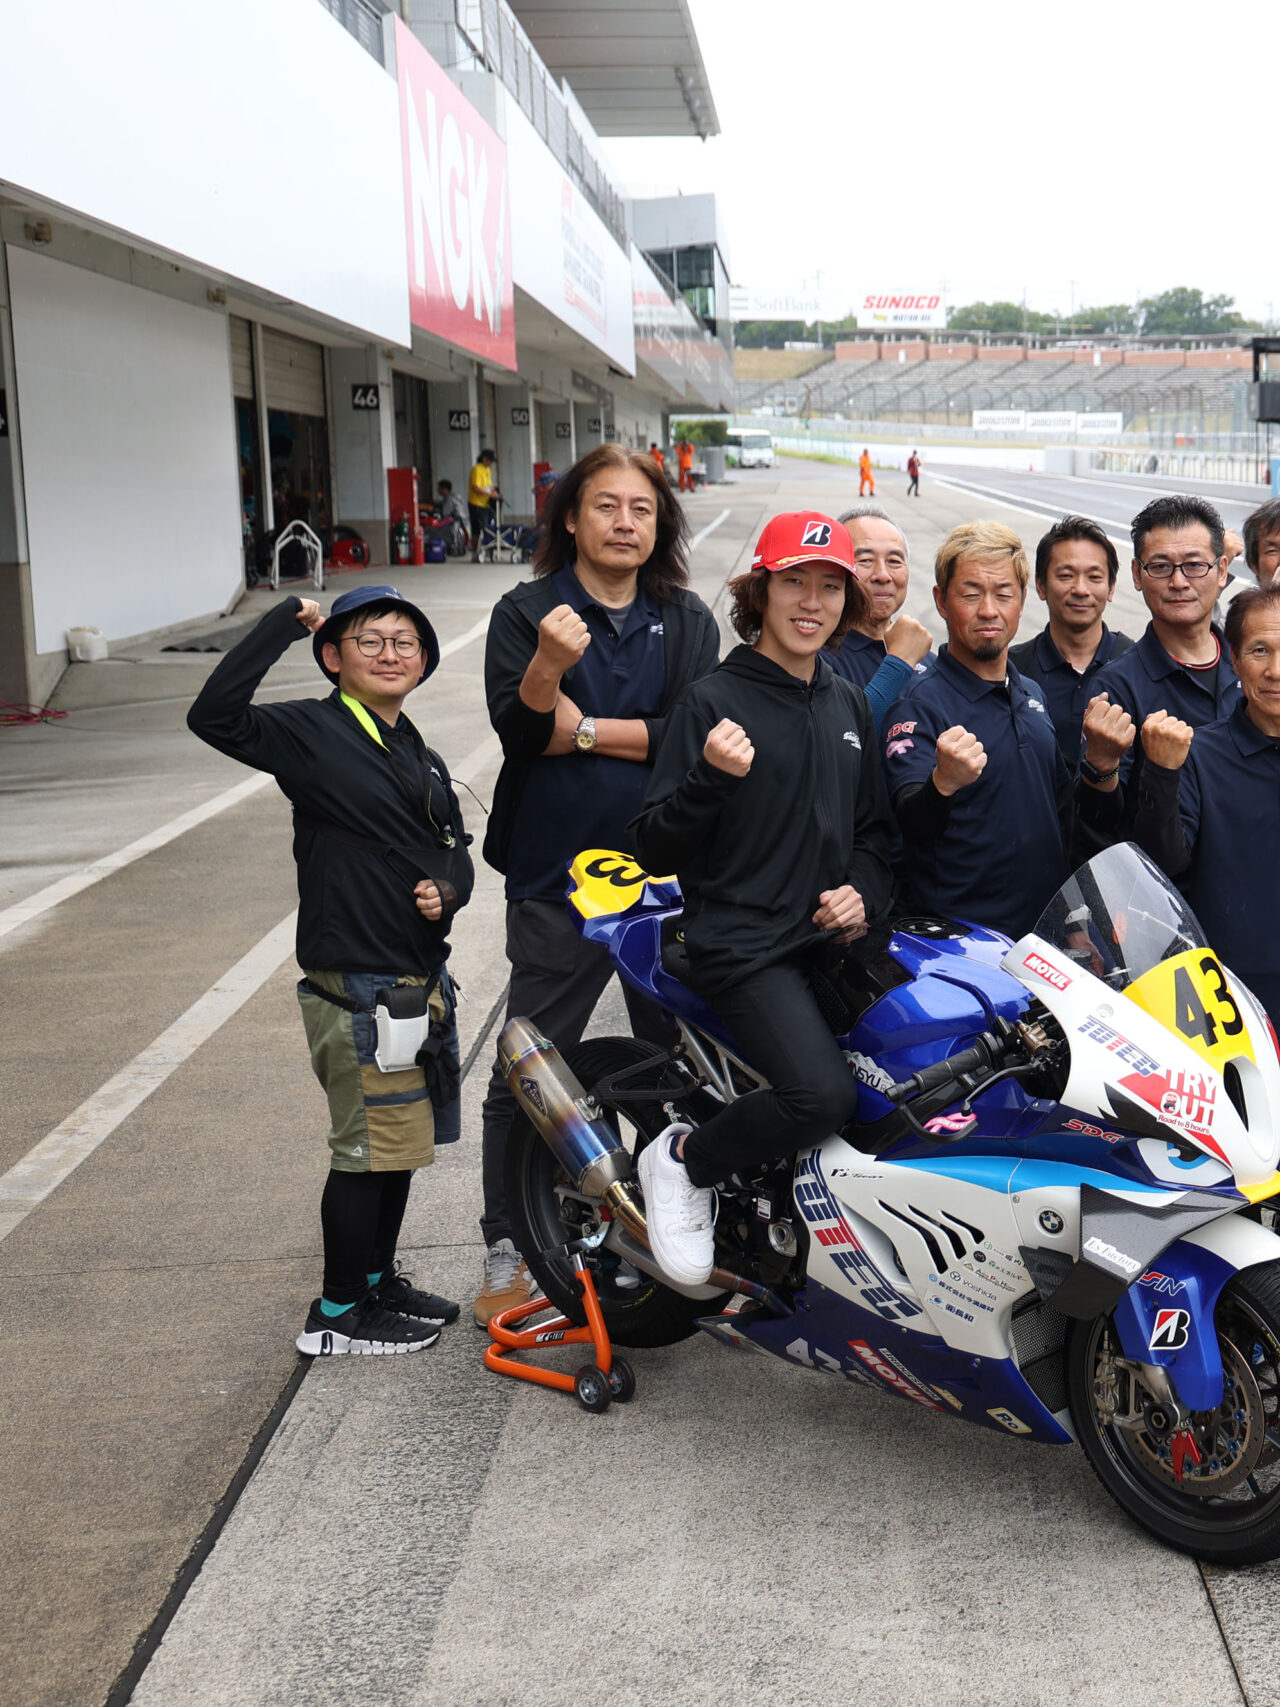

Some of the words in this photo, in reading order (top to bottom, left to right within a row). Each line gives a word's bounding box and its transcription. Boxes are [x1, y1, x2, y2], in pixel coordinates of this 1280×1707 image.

[404, 66, 504, 335] NGK
[863, 295, 940, 309] SUNOCO
[353, 387, 378, 408] 46
[450, 413, 470, 429] 48
[512, 410, 529, 423] 50
[1026, 955, 1068, 989] MOTUL
[1174, 957, 1243, 1047] 43
[1165, 1068, 1216, 1103] TRY
[1160, 1091, 1214, 1126] OUT
[1061, 1119, 1124, 1144] SDG
[1158, 1115, 1177, 1126] Road
[1190, 1123, 1210, 1134] hours
[962, 1279, 997, 1301] yoshida
[852, 1344, 936, 1410] MOTUL
